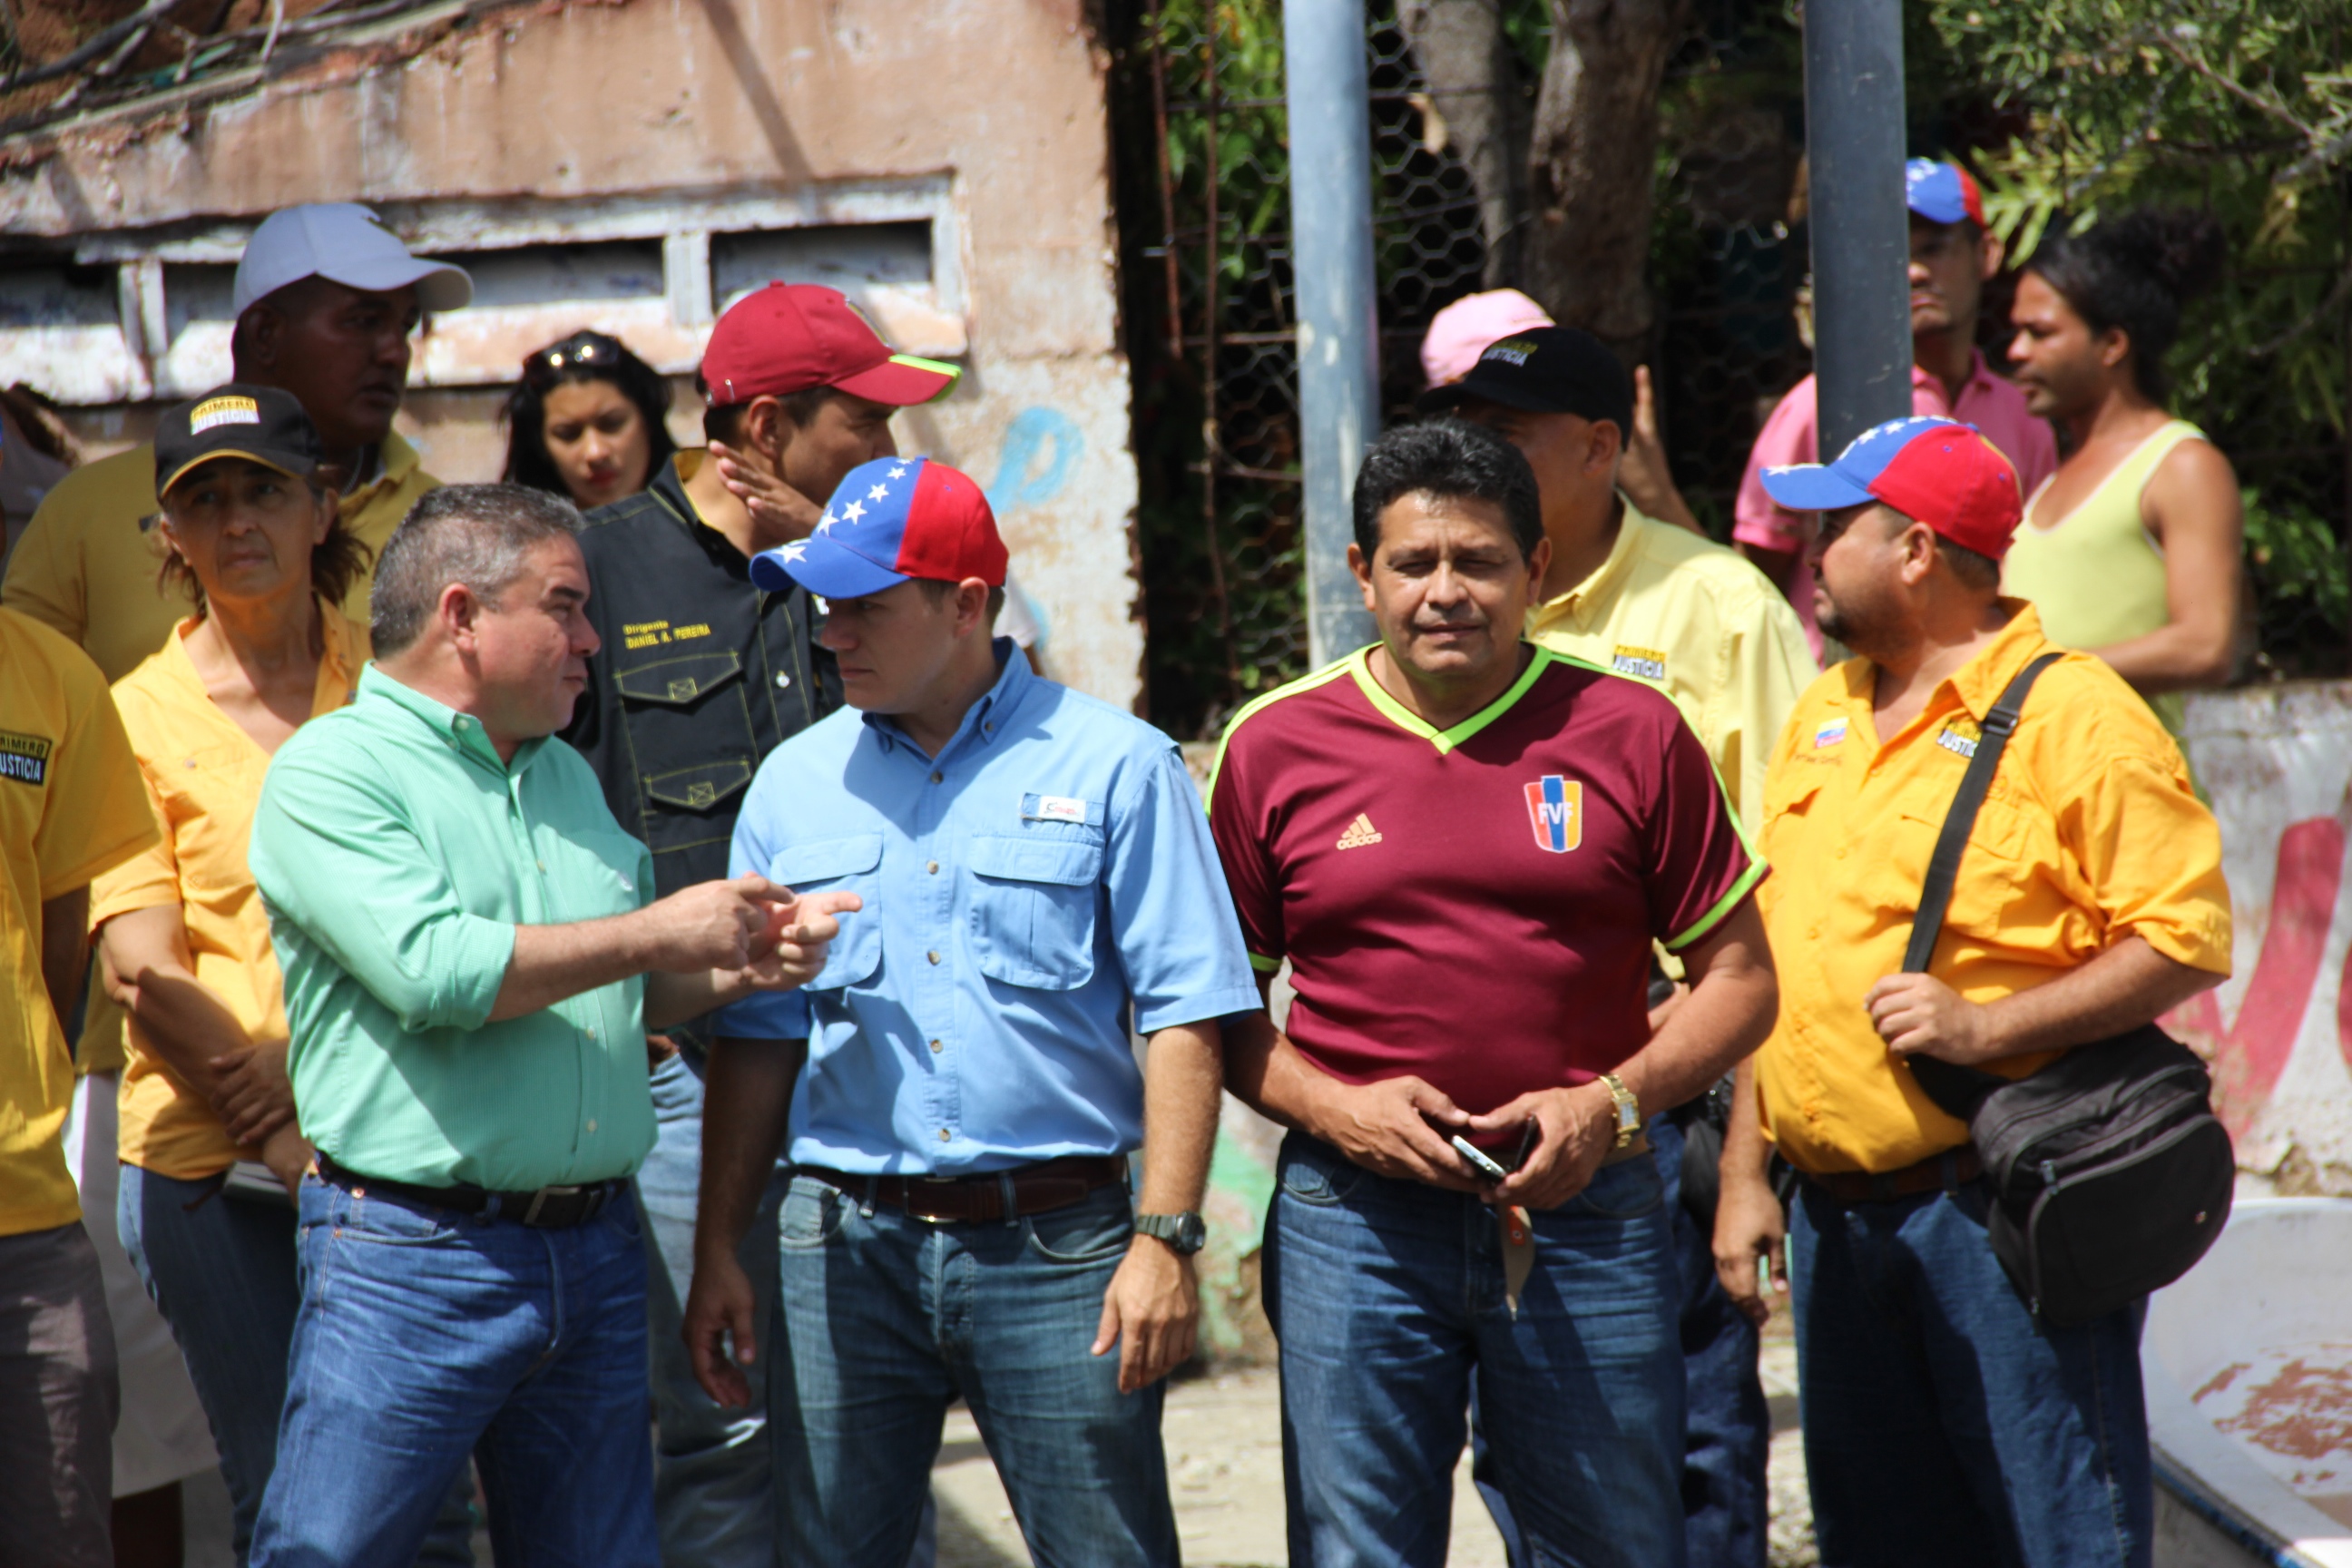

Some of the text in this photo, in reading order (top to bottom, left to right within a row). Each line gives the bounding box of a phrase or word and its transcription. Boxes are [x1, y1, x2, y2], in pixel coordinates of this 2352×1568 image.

[191, 409, 260, 436] JUSTICIA
[622, 620, 669, 635] Dirigente
[625, 623, 711, 650] DANIEL A. PEREIRA
[1612, 654, 1664, 680] JUSTICIA
[1537, 801, 1574, 825] FVF
[1336, 832, 1383, 851] adidas
